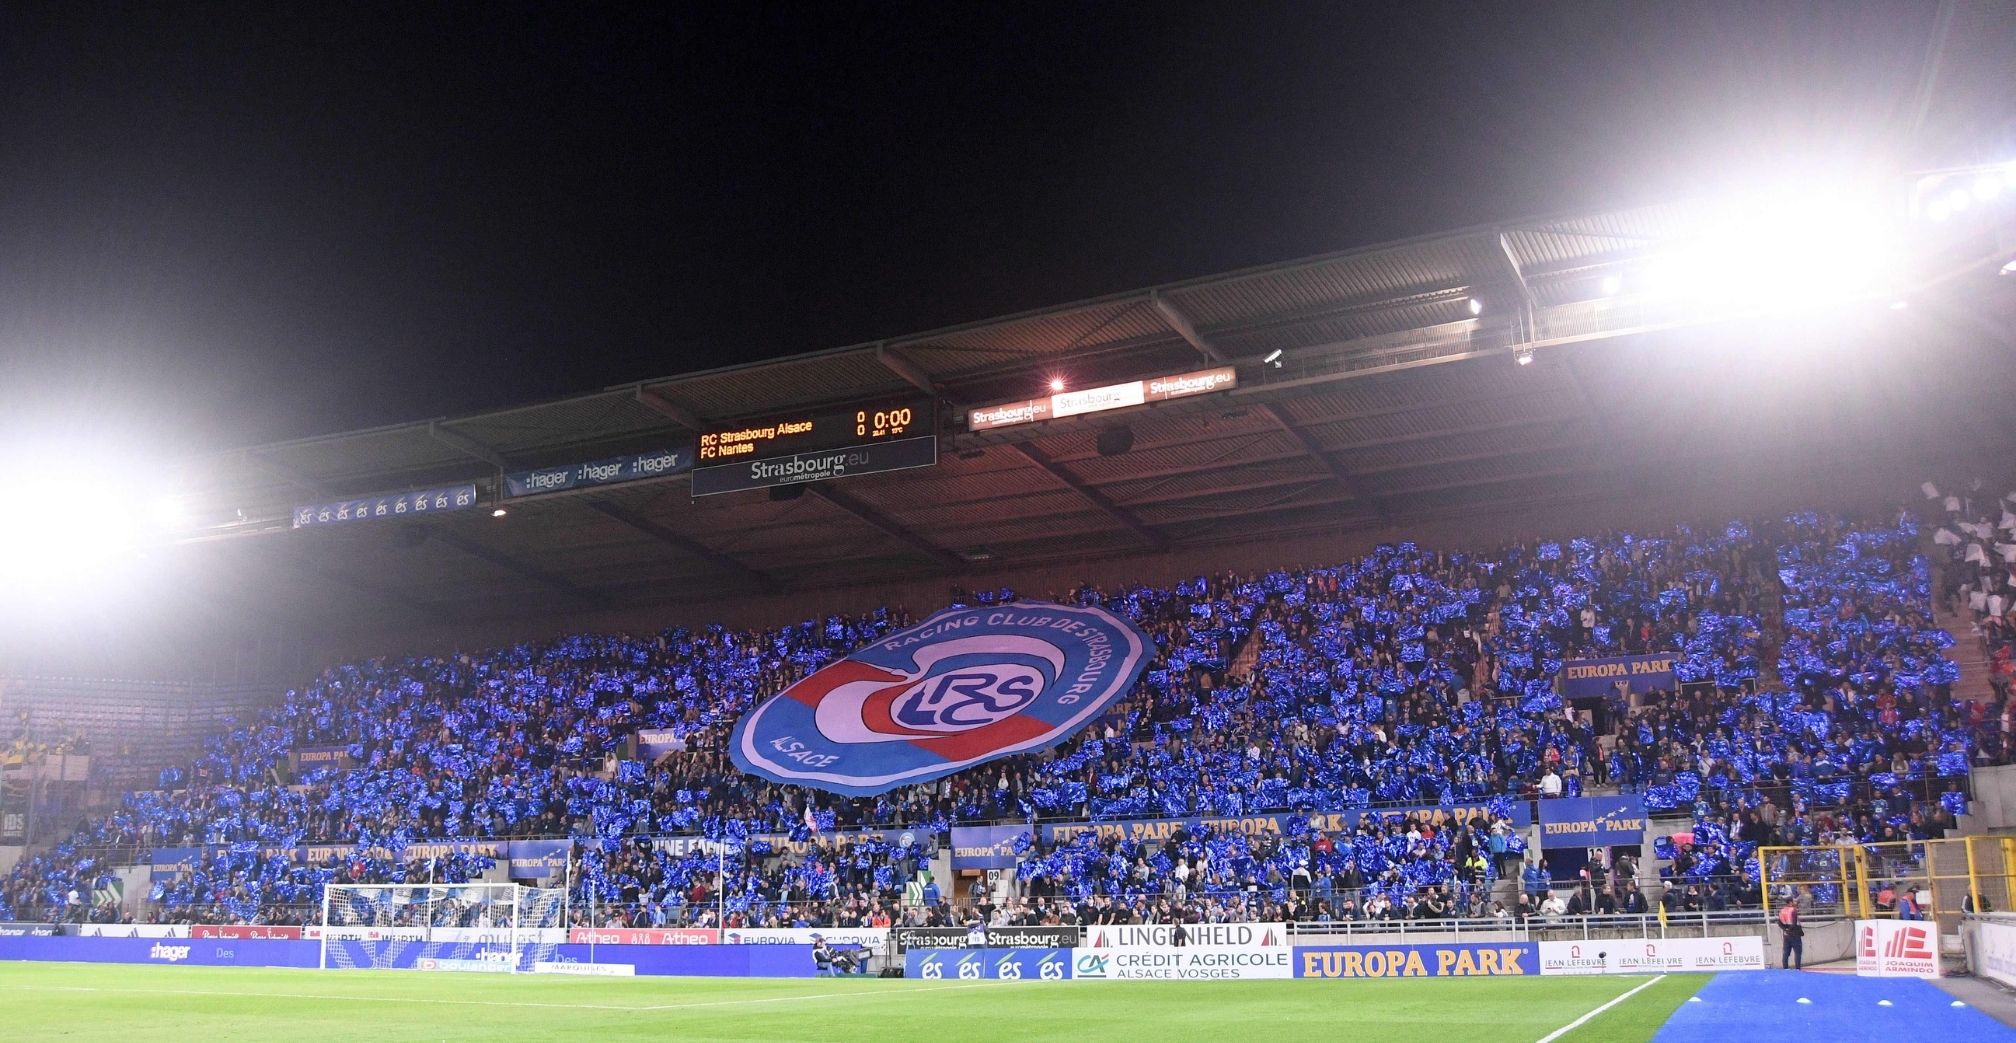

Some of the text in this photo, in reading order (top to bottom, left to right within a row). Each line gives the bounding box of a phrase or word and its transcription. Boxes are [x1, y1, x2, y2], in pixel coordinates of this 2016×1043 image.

[874, 408, 911, 429] 0:00
[701, 411, 866, 447] RC Strasbourg Alsace 0
[701, 424, 866, 459] FC Nantes 0
[751, 450, 869, 480] Strasbourg.eu
[779, 470, 831, 483] eurométropole
[883, 613, 1112, 704] RACING CLUB DE STRASBOURG
[1567, 659, 1672, 680] EUROPA PARK
[639, 733, 677, 744] EUROPA
[300, 752, 331, 761] EUROPA
[769, 735, 839, 769] ALSACE
[1545, 818, 1642, 834] EUROPA PARK
[955, 847, 995, 857] EUROPA
[153, 864, 178, 872] EUROPA
[512, 858, 543, 867] EUROPA
[988, 871, 999, 880] 09
[662, 931, 709, 944] Atheo
[744, 936, 796, 945] EUROVIA
[216, 947, 234, 958] Des
[1116, 952, 1288, 967] CRÉDIT AGRICOLE
[1303, 948, 1524, 978] EUROPA PARK
[1567, 958, 1607, 967] LEFEBVRE
[1696, 955, 1760, 964] JEAN LEFEBVRE
[1885, 960, 1934, 968] JOAQUIM
[1117, 969, 1240, 979] ALSACE VOSGES
[1885, 966, 1934, 974] ARMINDO
